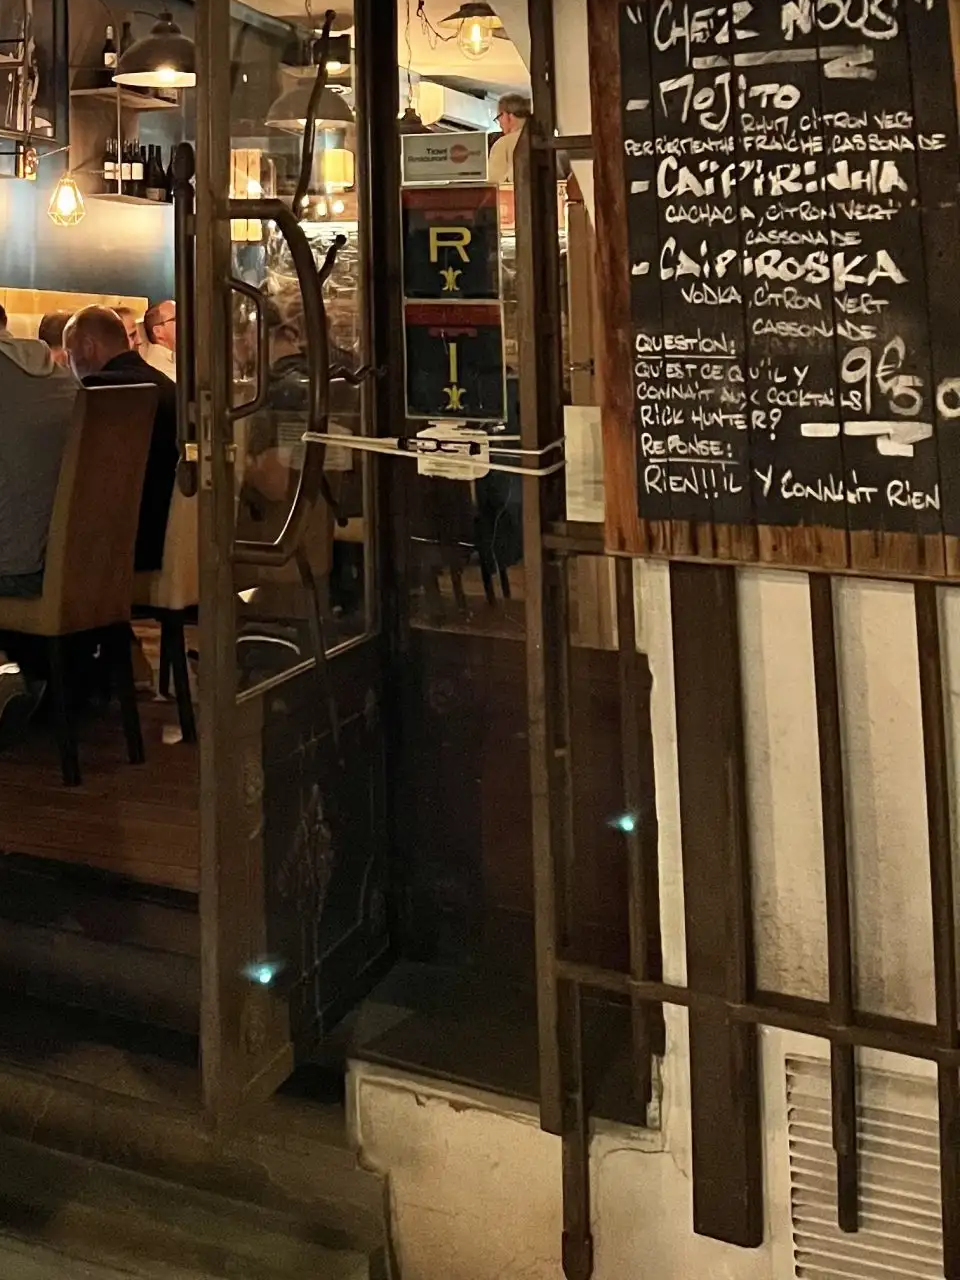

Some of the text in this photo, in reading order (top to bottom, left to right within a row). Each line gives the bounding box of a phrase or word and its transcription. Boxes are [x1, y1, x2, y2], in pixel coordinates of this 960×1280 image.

[429, 226, 471, 263] R
[834, 293, 890, 314] VERT
[448, 342, 458, 383] I
[793, 365, 810, 386] Y
[754, 464, 773, 498] Y
